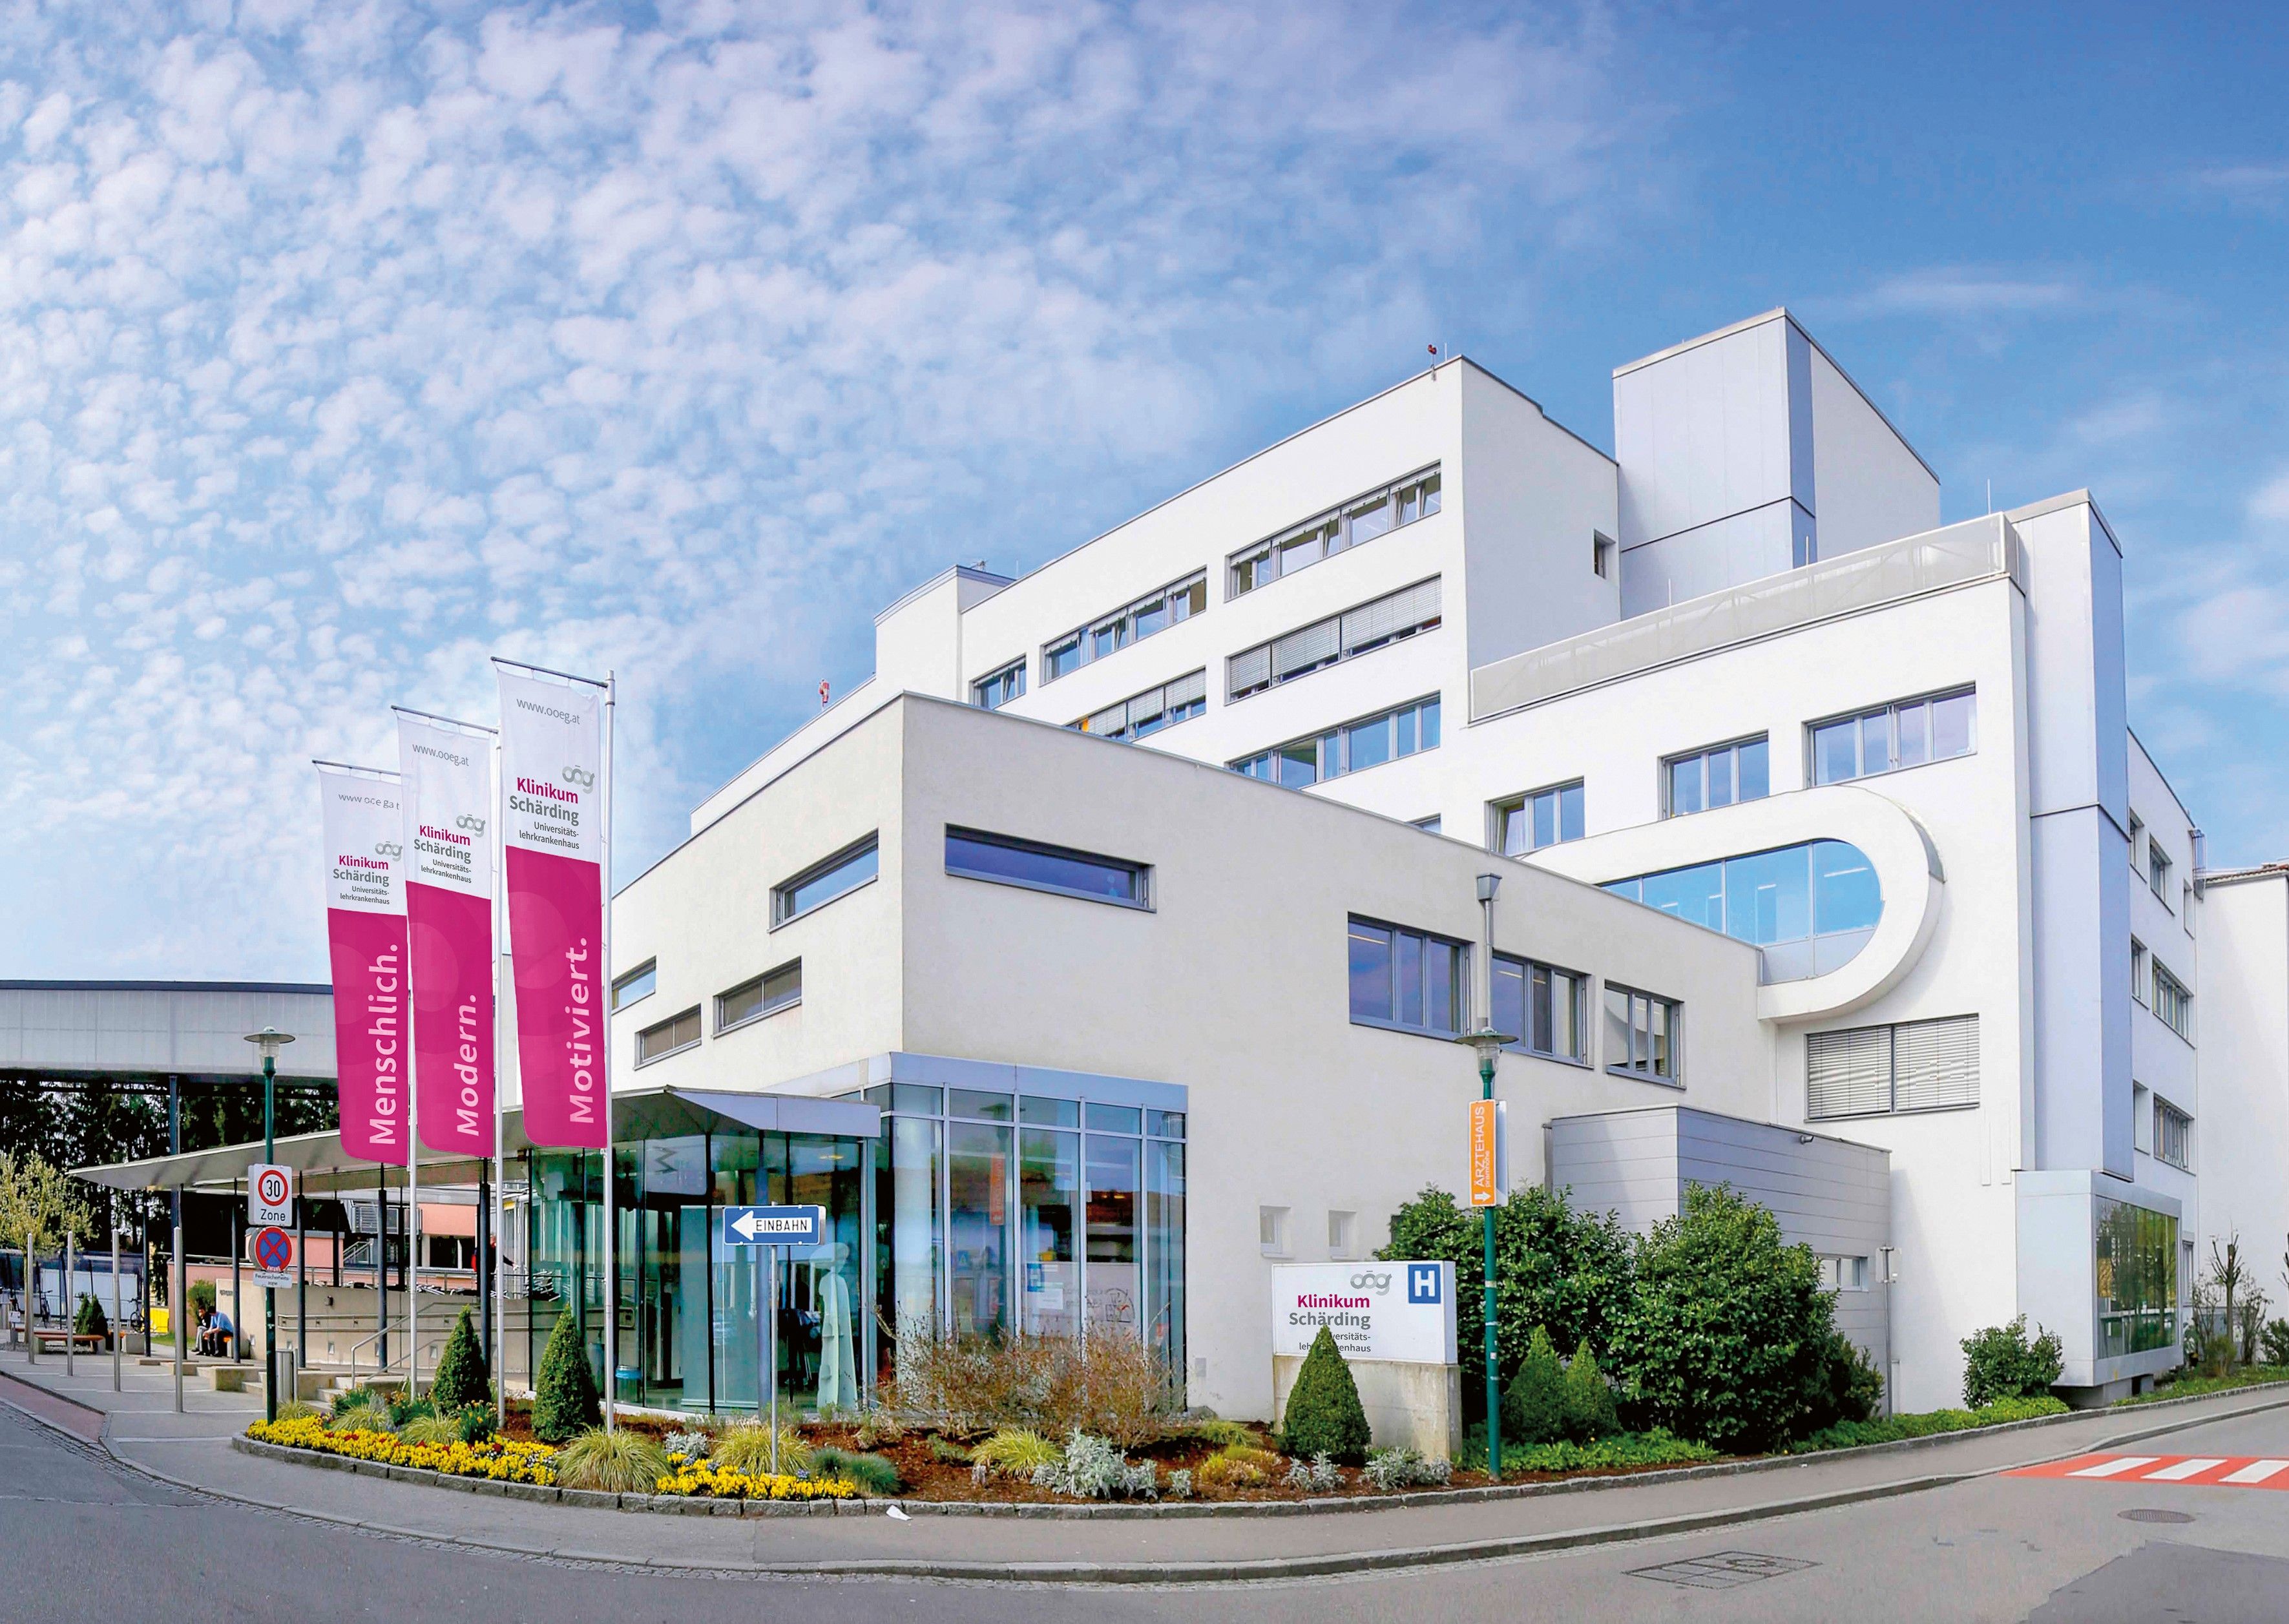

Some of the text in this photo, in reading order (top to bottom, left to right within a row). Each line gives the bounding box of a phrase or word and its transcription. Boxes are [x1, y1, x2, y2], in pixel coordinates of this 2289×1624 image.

[516, 698, 580, 724] www.ooeg.at
[412, 744, 469, 766] www.ooeg.at
[517, 777, 578, 804] Klinikum
[510, 795, 579, 827] Schärding
[419, 825, 470, 846] Klinikum
[534, 821, 579, 837] Universitäts-
[519, 829, 580, 849] lehrkrankenhaus
[414, 839, 471, 864] Schärding
[339, 855, 388, 870] Klinikum
[432, 859, 472, 873] Universitäts-
[333, 868, 390, 887] Schärding
[421, 865, 472, 884] lehrkrankenhaus
[340, 893, 390, 905] lehrkrankenhaus
[351, 886, 390, 896] Universitäts-
[565, 937, 594, 1123] Motiviert.
[368, 944, 398, 1145] Menschlich.
[454, 994, 479, 1137] Modern.
[1474, 1106, 1485, 1187] ÄRZTEHAUS
[266, 1180, 280, 1198] 30
[260, 1209, 286, 1221] Zone
[756, 1220, 807, 1231] EINBAHN
[1414, 1270, 1436, 1297] H
[1297, 1294, 1370, 1308] Klinikum
[1289, 1312, 1371, 1330] Schärding
